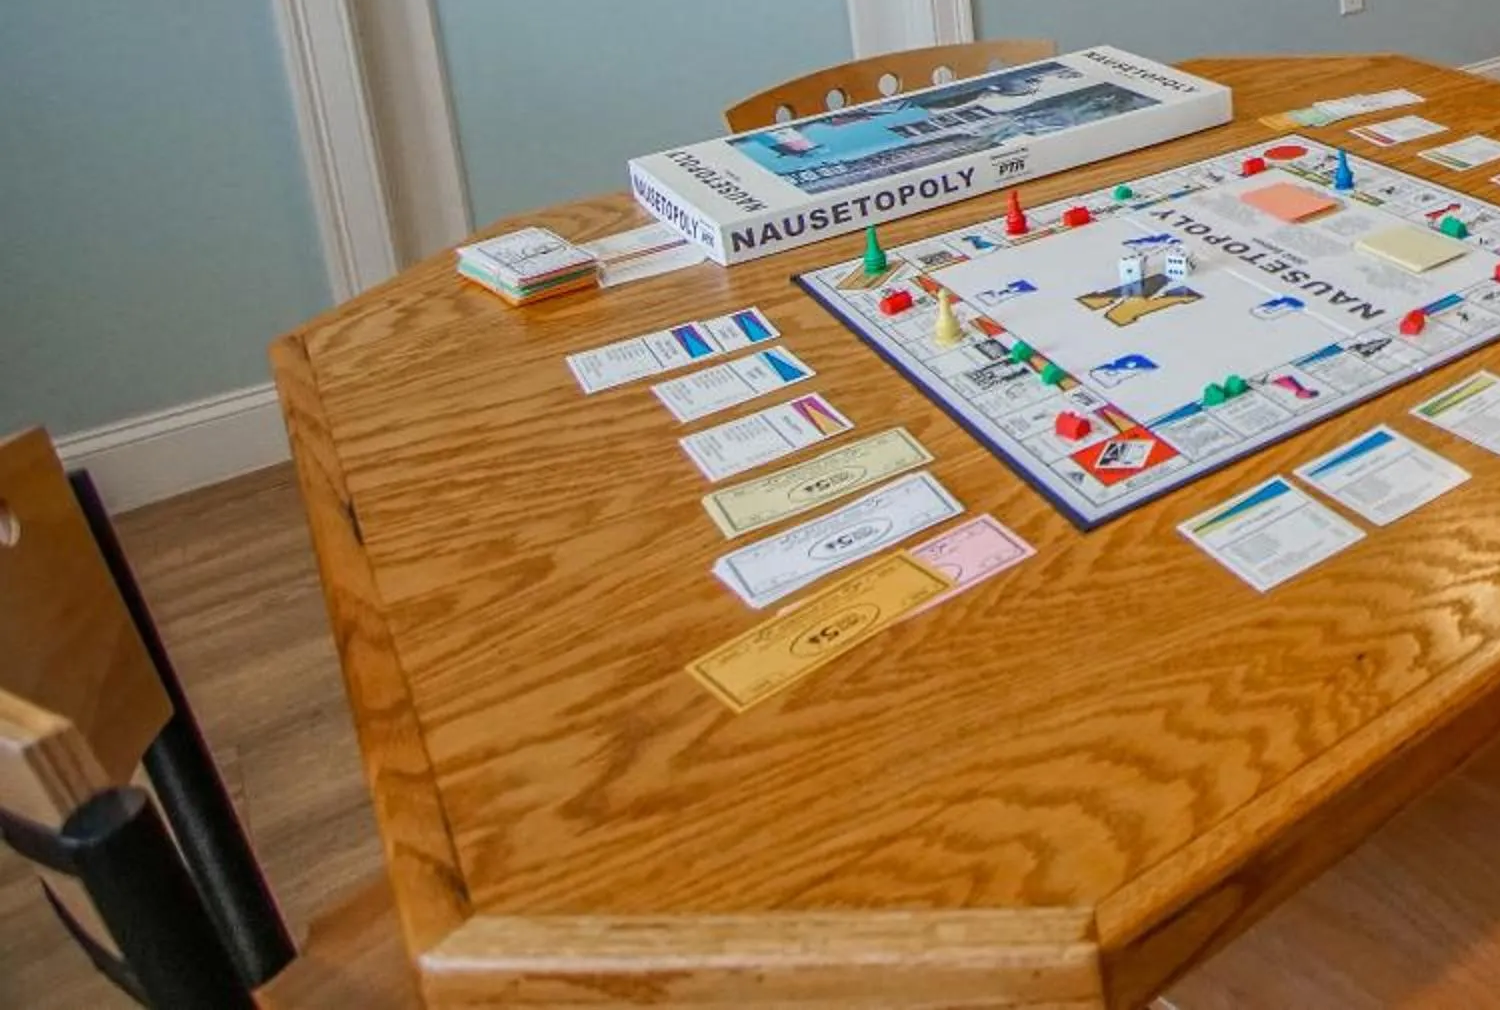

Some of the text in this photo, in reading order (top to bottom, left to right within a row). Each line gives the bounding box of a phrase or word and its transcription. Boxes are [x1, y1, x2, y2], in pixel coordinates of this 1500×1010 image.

[633, 174, 699, 242] NAUSETOPOLY
[731, 166, 976, 252] NAUSETOPOLY
[1149, 209, 1386, 320] NAUSETOPOLY
